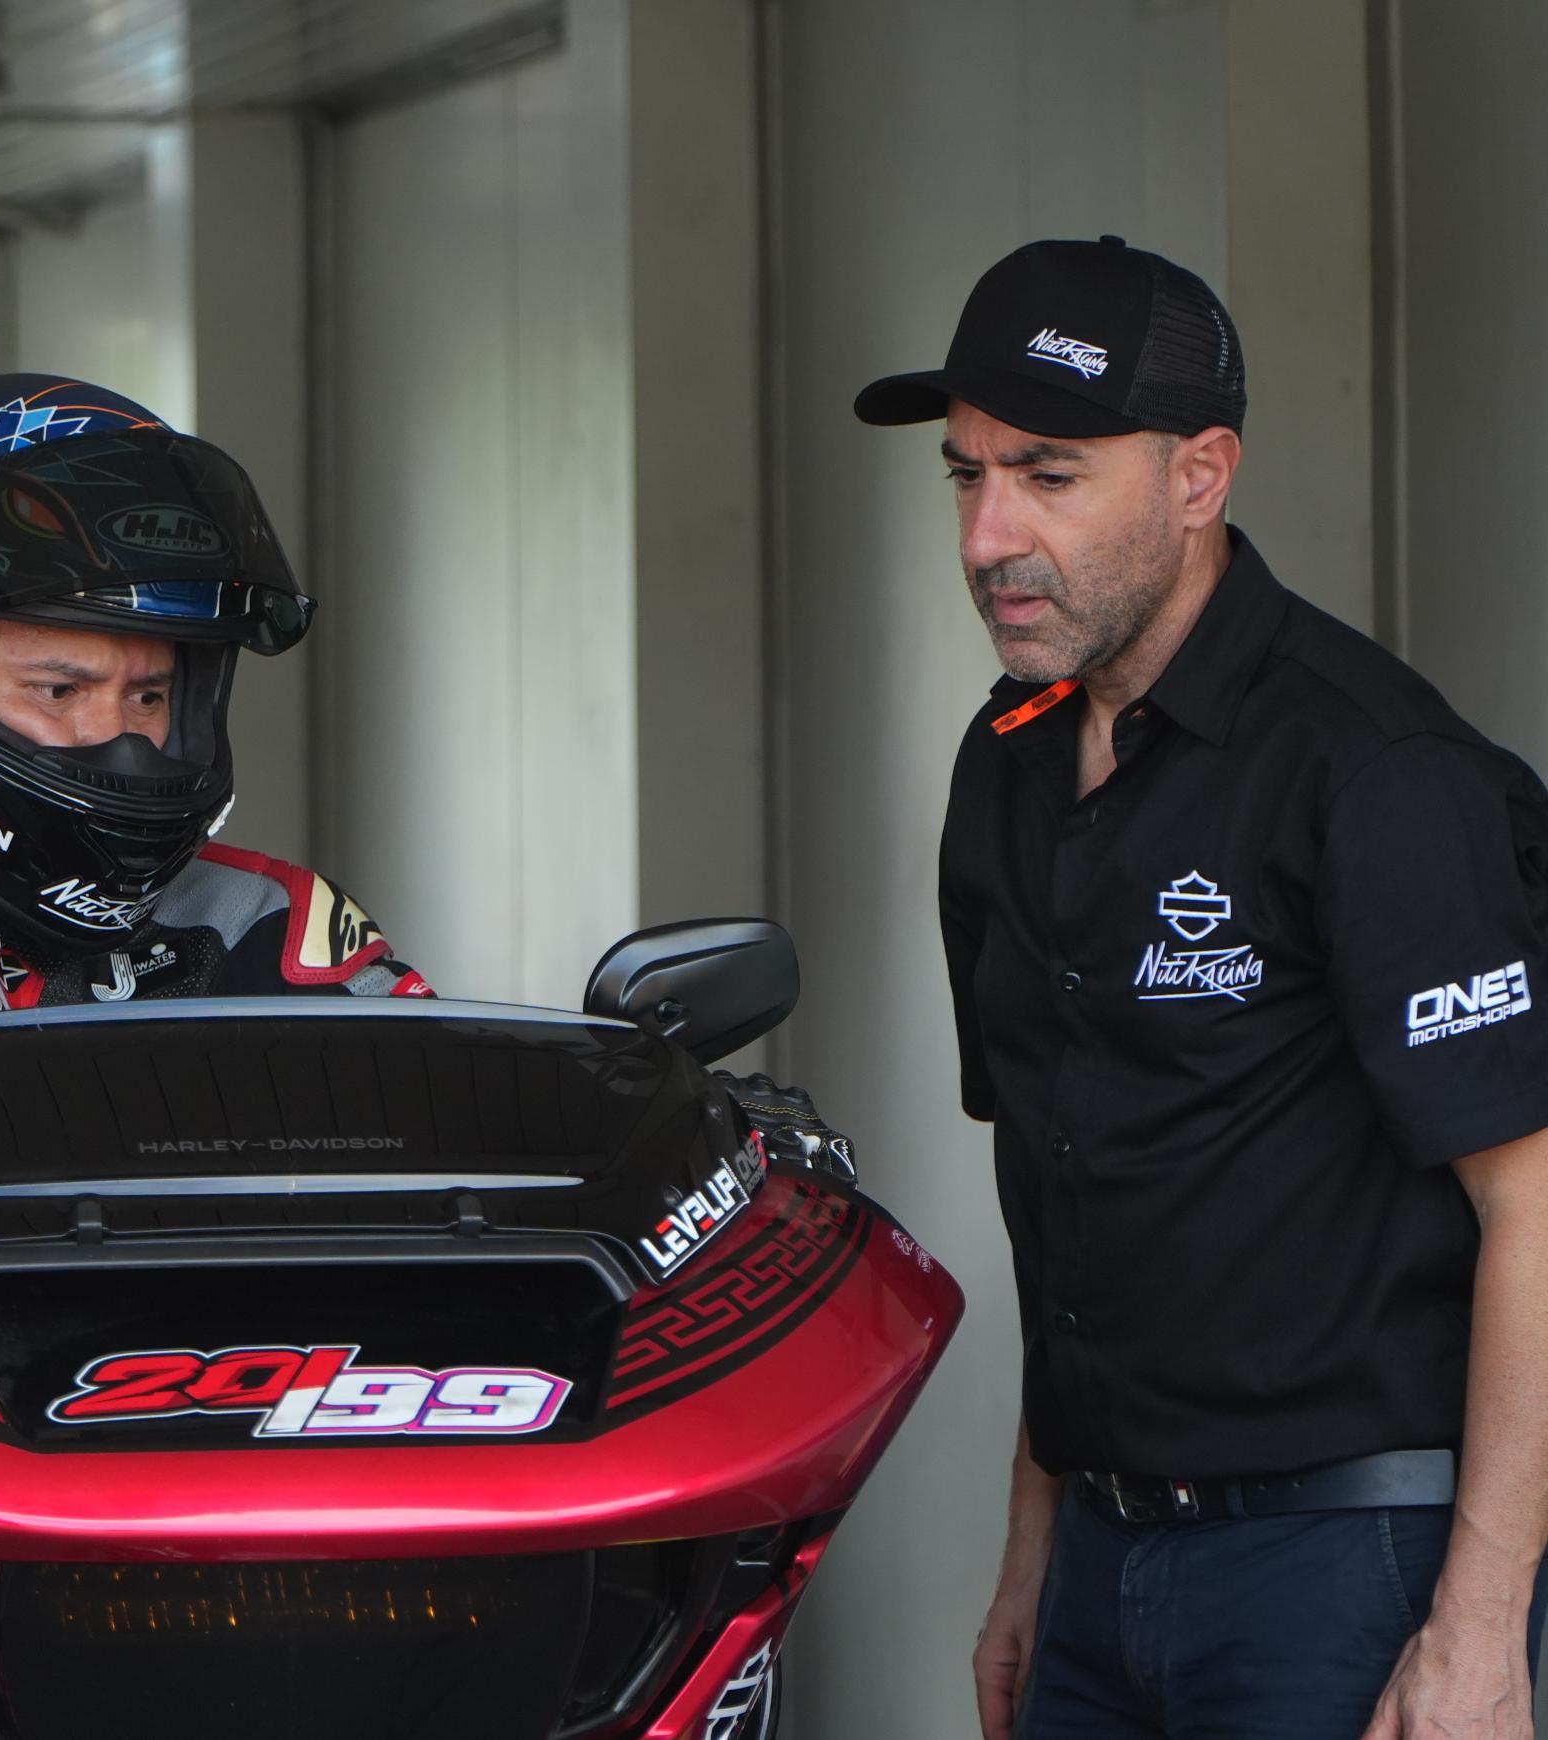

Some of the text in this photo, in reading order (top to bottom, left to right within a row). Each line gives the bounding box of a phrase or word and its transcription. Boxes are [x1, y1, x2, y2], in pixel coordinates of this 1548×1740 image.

[122, 513, 213, 545] HJC
[1407, 959, 1532, 1030] ONE3
[1408, 1004, 1512, 1048] MOTOSHOP
